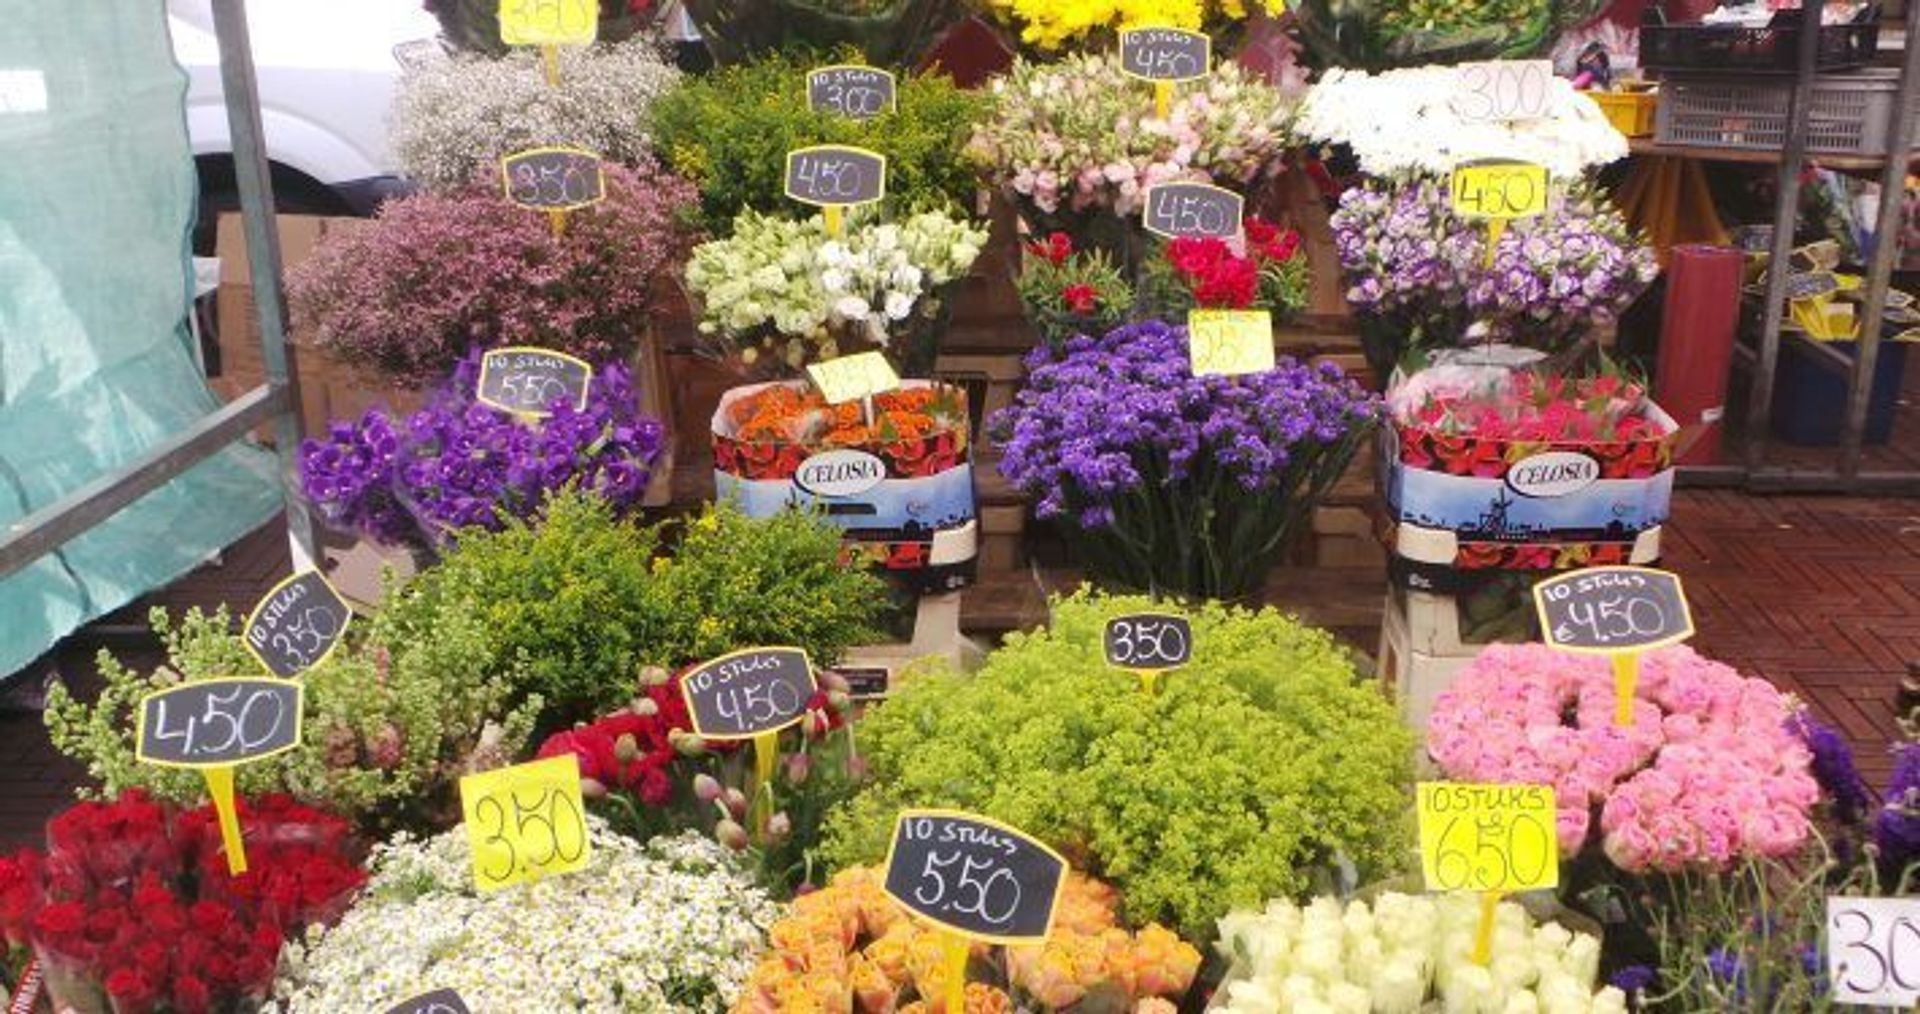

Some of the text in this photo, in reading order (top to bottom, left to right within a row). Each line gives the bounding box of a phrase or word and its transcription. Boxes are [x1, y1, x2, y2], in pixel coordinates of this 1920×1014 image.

[803, 460, 878, 485] CELOSIA
[1516, 461, 1592, 486] CELOSIA
[1544, 583, 1571, 602] 10
[689, 671, 712, 694] 10
[476, 789, 585, 883] 3.50
[904, 818, 934, 841] 10
